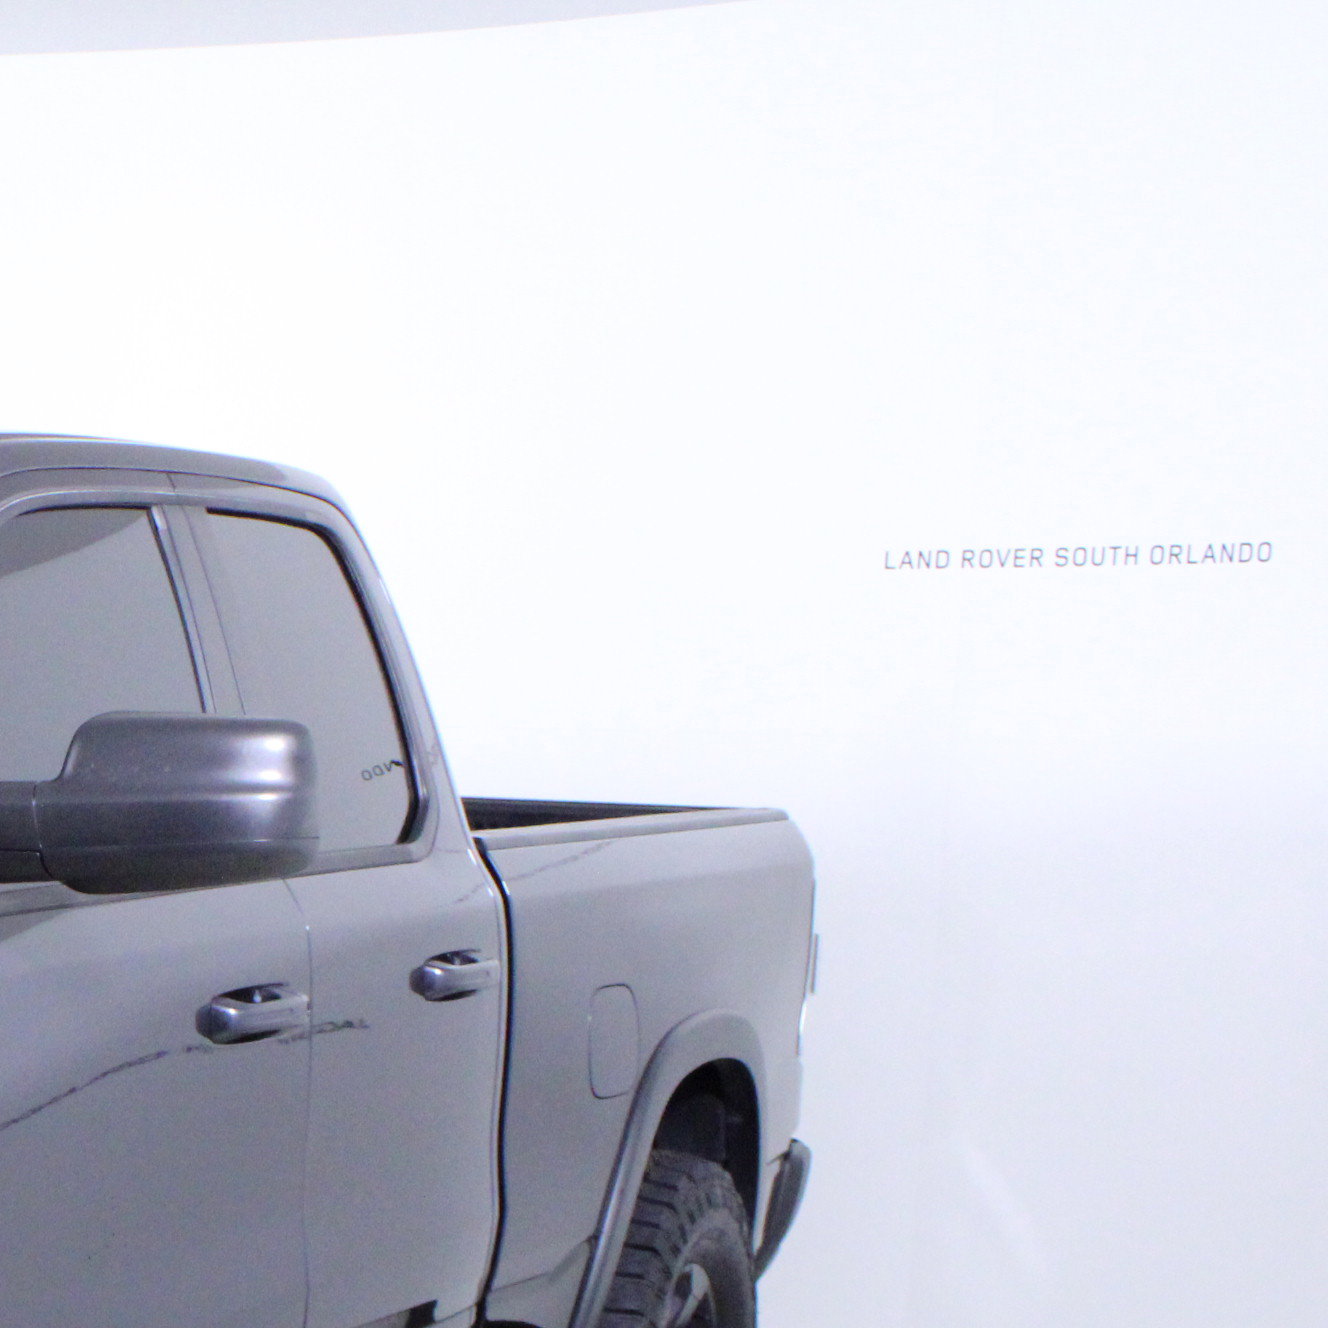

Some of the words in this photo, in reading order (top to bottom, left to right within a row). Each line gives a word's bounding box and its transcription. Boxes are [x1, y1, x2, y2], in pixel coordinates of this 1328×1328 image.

[884, 548, 951, 571] LAND
[960, 546, 1045, 570] ROVER
[1053, 544, 1140, 569] SOUTH
[1149, 541, 1274, 567] ORLANDO
